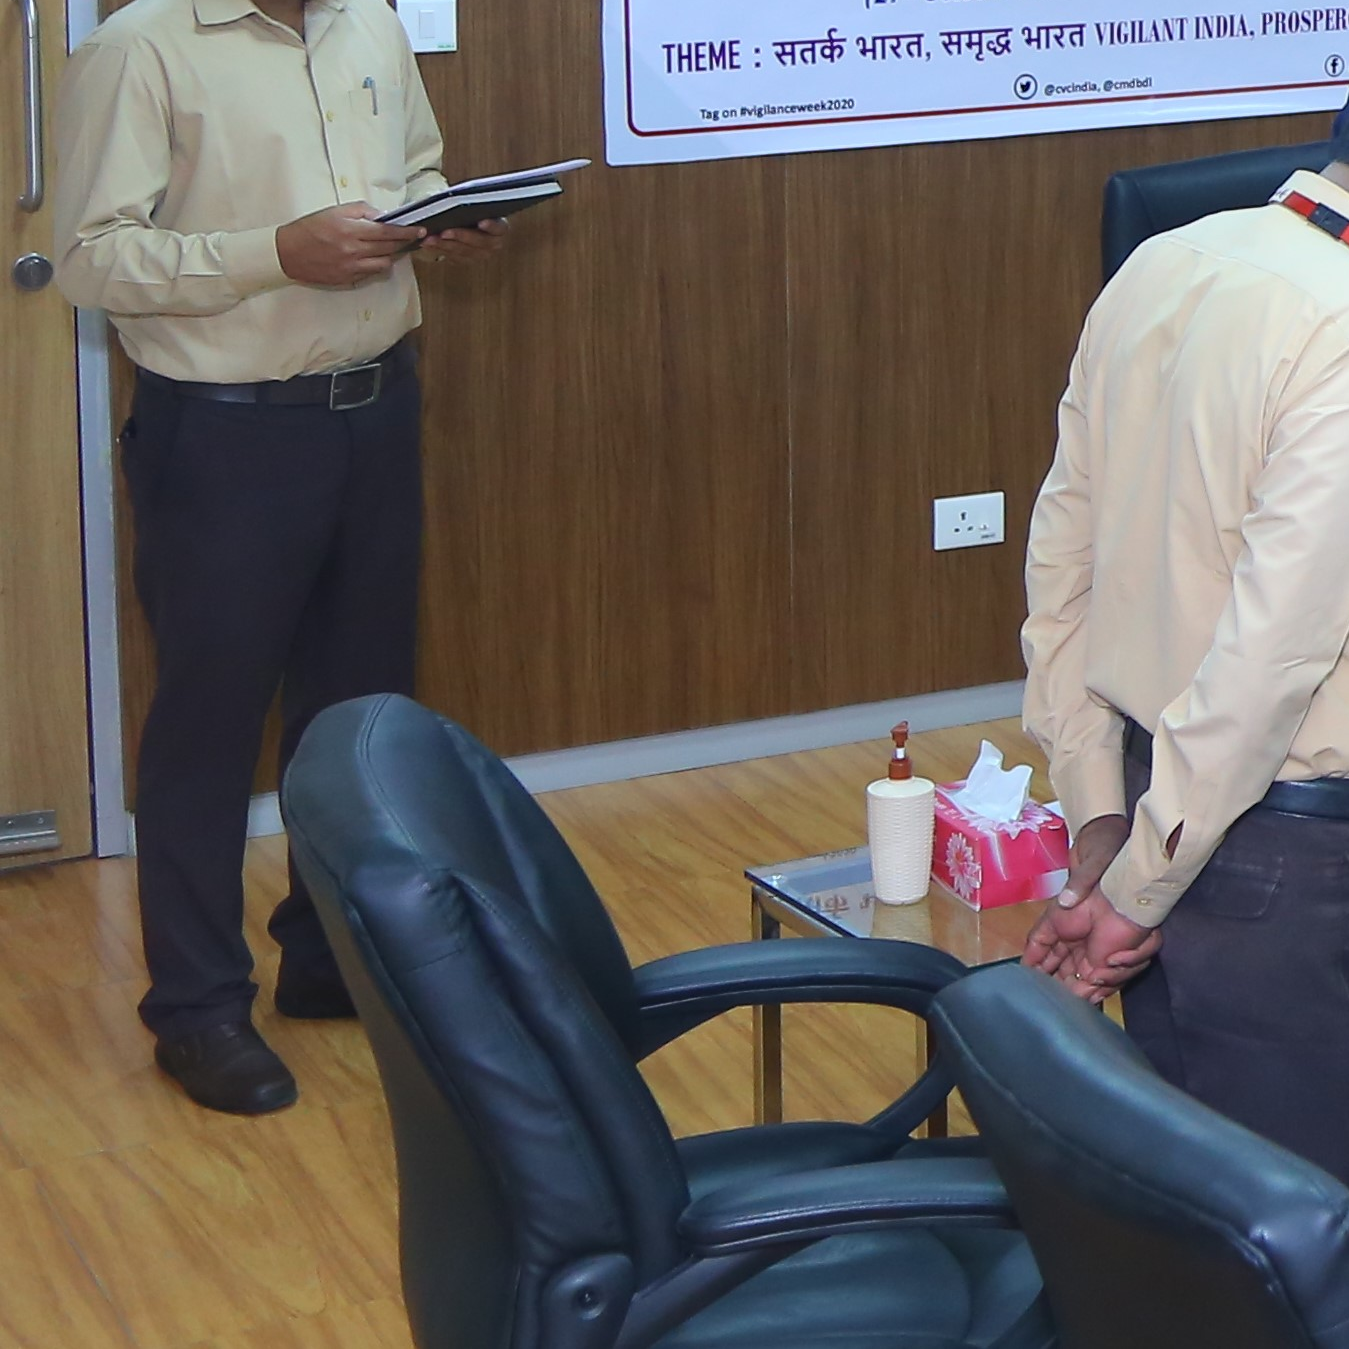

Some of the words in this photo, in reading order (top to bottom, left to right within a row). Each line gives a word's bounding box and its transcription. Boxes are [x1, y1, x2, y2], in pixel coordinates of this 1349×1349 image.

[662, 40, 741, 74] THEME
[753, 46, 762, 68] :
[773, 27, 847, 67] सतर्क
[855, 33, 932, 63] भारत,
[939, 26, 1014, 63] समृद्ध
[1021, 23, 1087, 51] भारत
[1095, 17, 1189, 46] VIGILANT
[1194, 12, 1256, 42] INDIA,
[1044, 81, 1101, 96] @cvcindia,
[1103, 77, 1152, 92] @cmdbdl
[700, 108, 720, 121] Tag
[722, 108, 738, 118] on
[740, 98, 855, 118] #vigilanceweek2020
